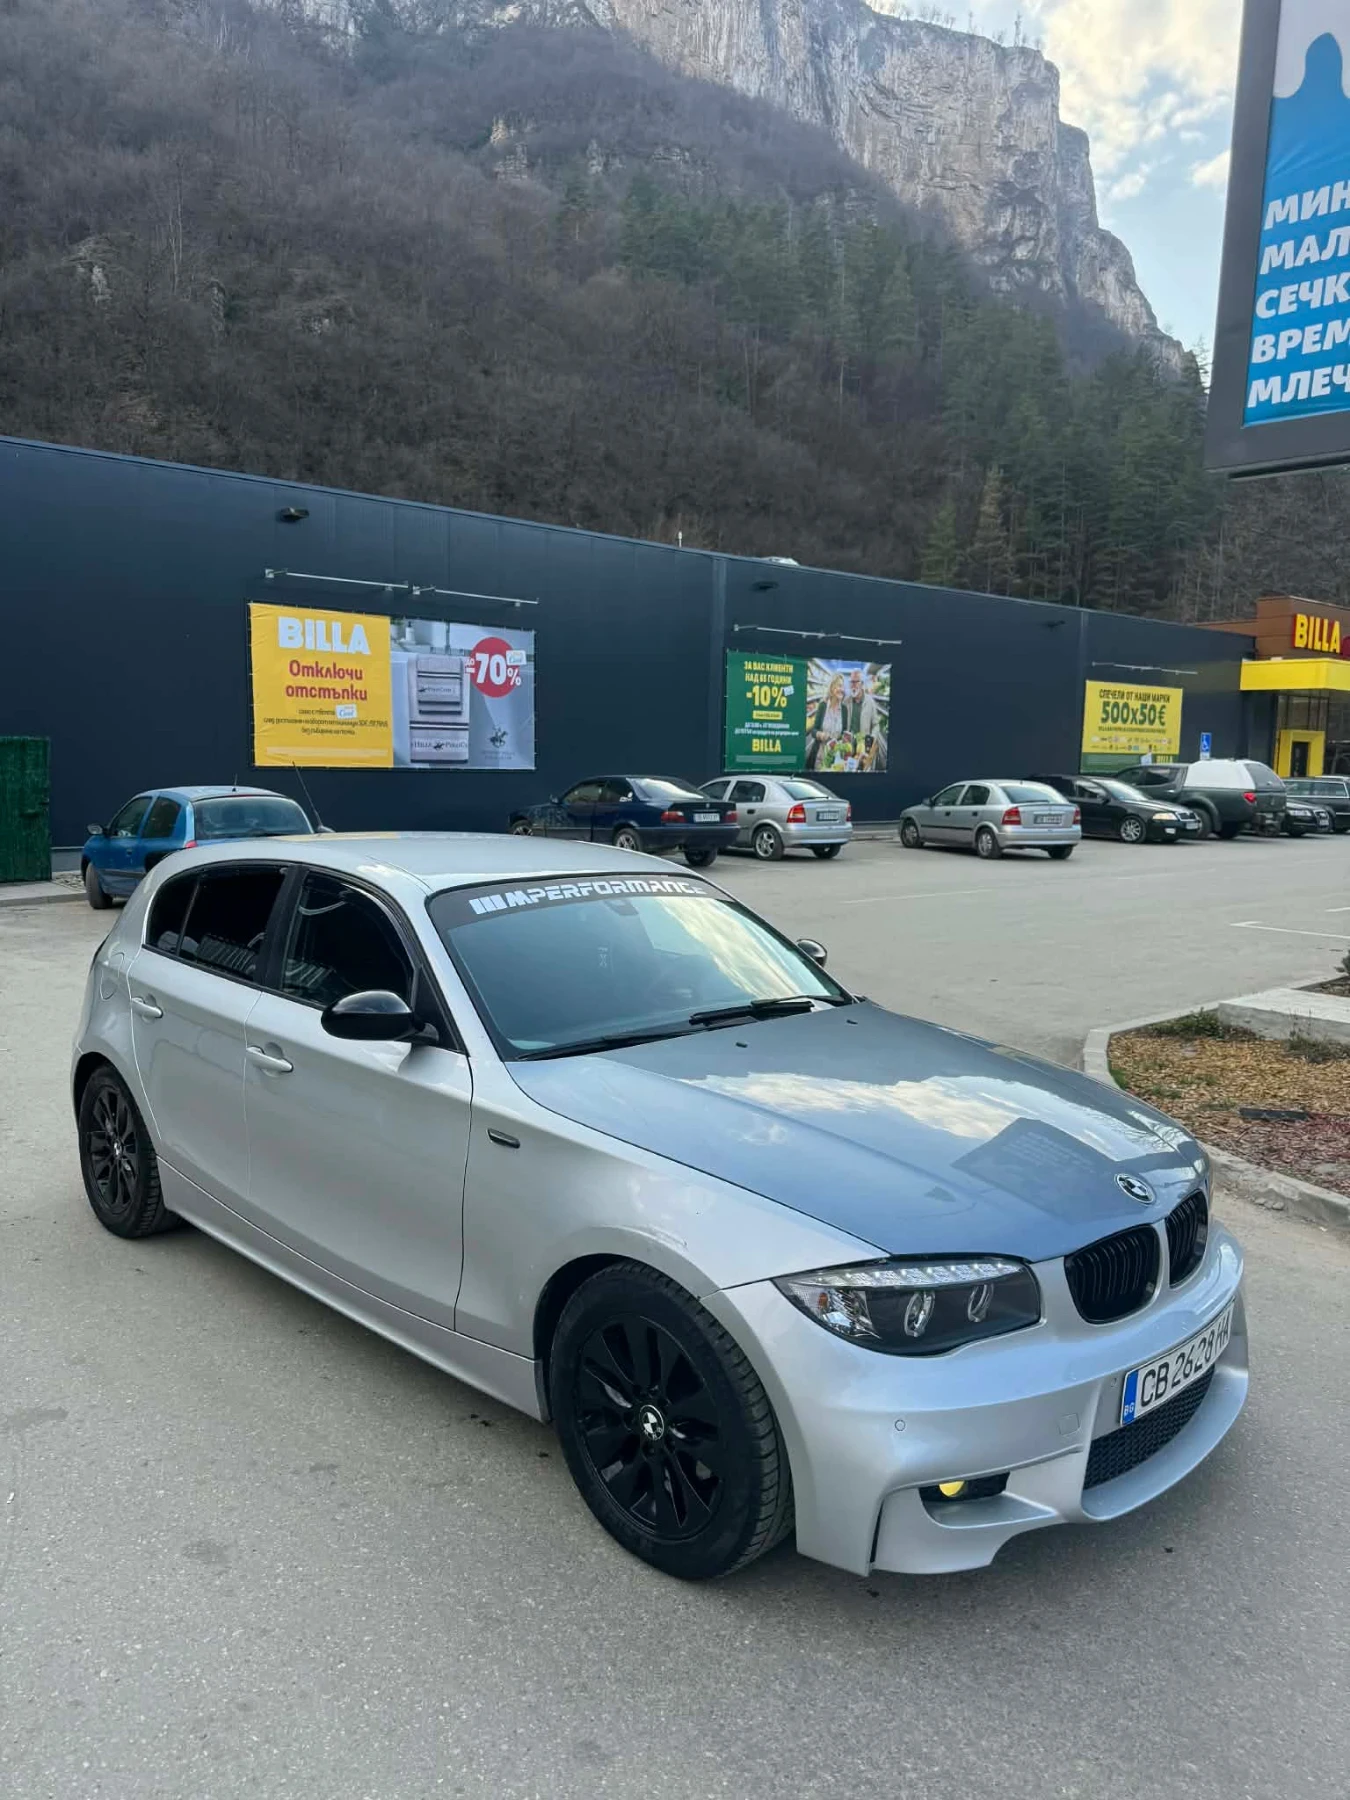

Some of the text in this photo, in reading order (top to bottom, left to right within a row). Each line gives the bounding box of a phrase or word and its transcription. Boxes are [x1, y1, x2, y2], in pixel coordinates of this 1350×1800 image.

[277, 616, 372, 655] BILLA
[1294, 613, 1341, 654] BILLA
[289, 659, 364, 681] Отключи
[466, 653, 522, 686] -70%
[285, 684, 368, 702] отстъпки
[746, 685, 787, 708] -10%
[752, 738, 782, 753] BILLA
[1124, 1402, 1135, 1417] BG
